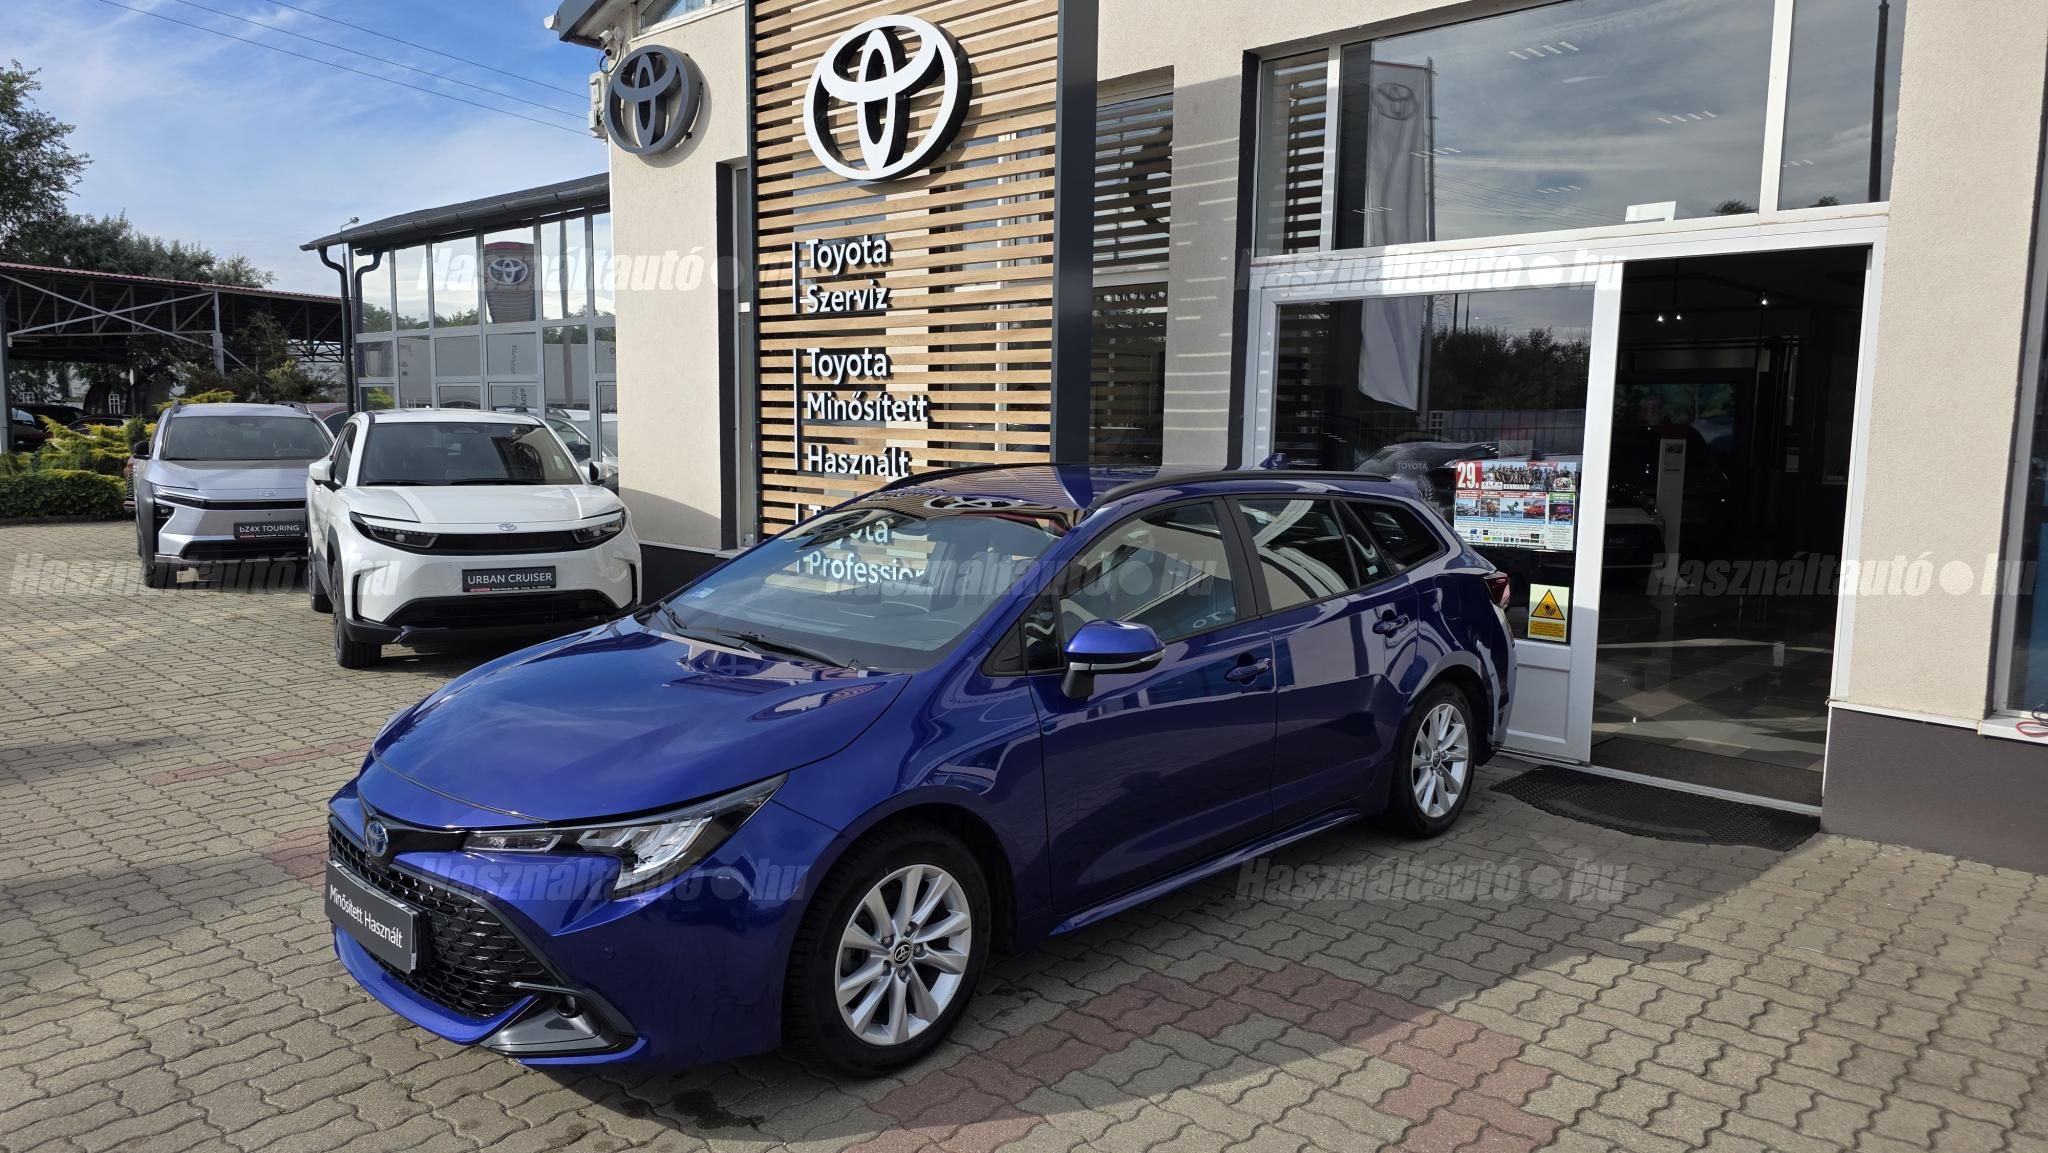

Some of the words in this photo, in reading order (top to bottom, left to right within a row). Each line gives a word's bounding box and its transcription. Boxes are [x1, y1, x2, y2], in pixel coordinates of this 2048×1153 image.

[805, 234, 888, 276] Toyota
[806, 279, 889, 314] Szerviz
[806, 347, 888, 386] Toyota
[807, 390, 929, 422] Minősített
[807, 444, 910, 478] Használt
[1397, 462, 1430, 472] TOYOTA
[1457, 462, 1479, 489] 29.
[239, 525, 260, 533] bZ4X
[262, 524, 300, 532] TOURING
[467, 574, 505, 585] URBAN
[507, 572, 553, 583] CRUISER
[329, 883, 364, 925] Minősített
[364, 910, 404, 949] Használt
